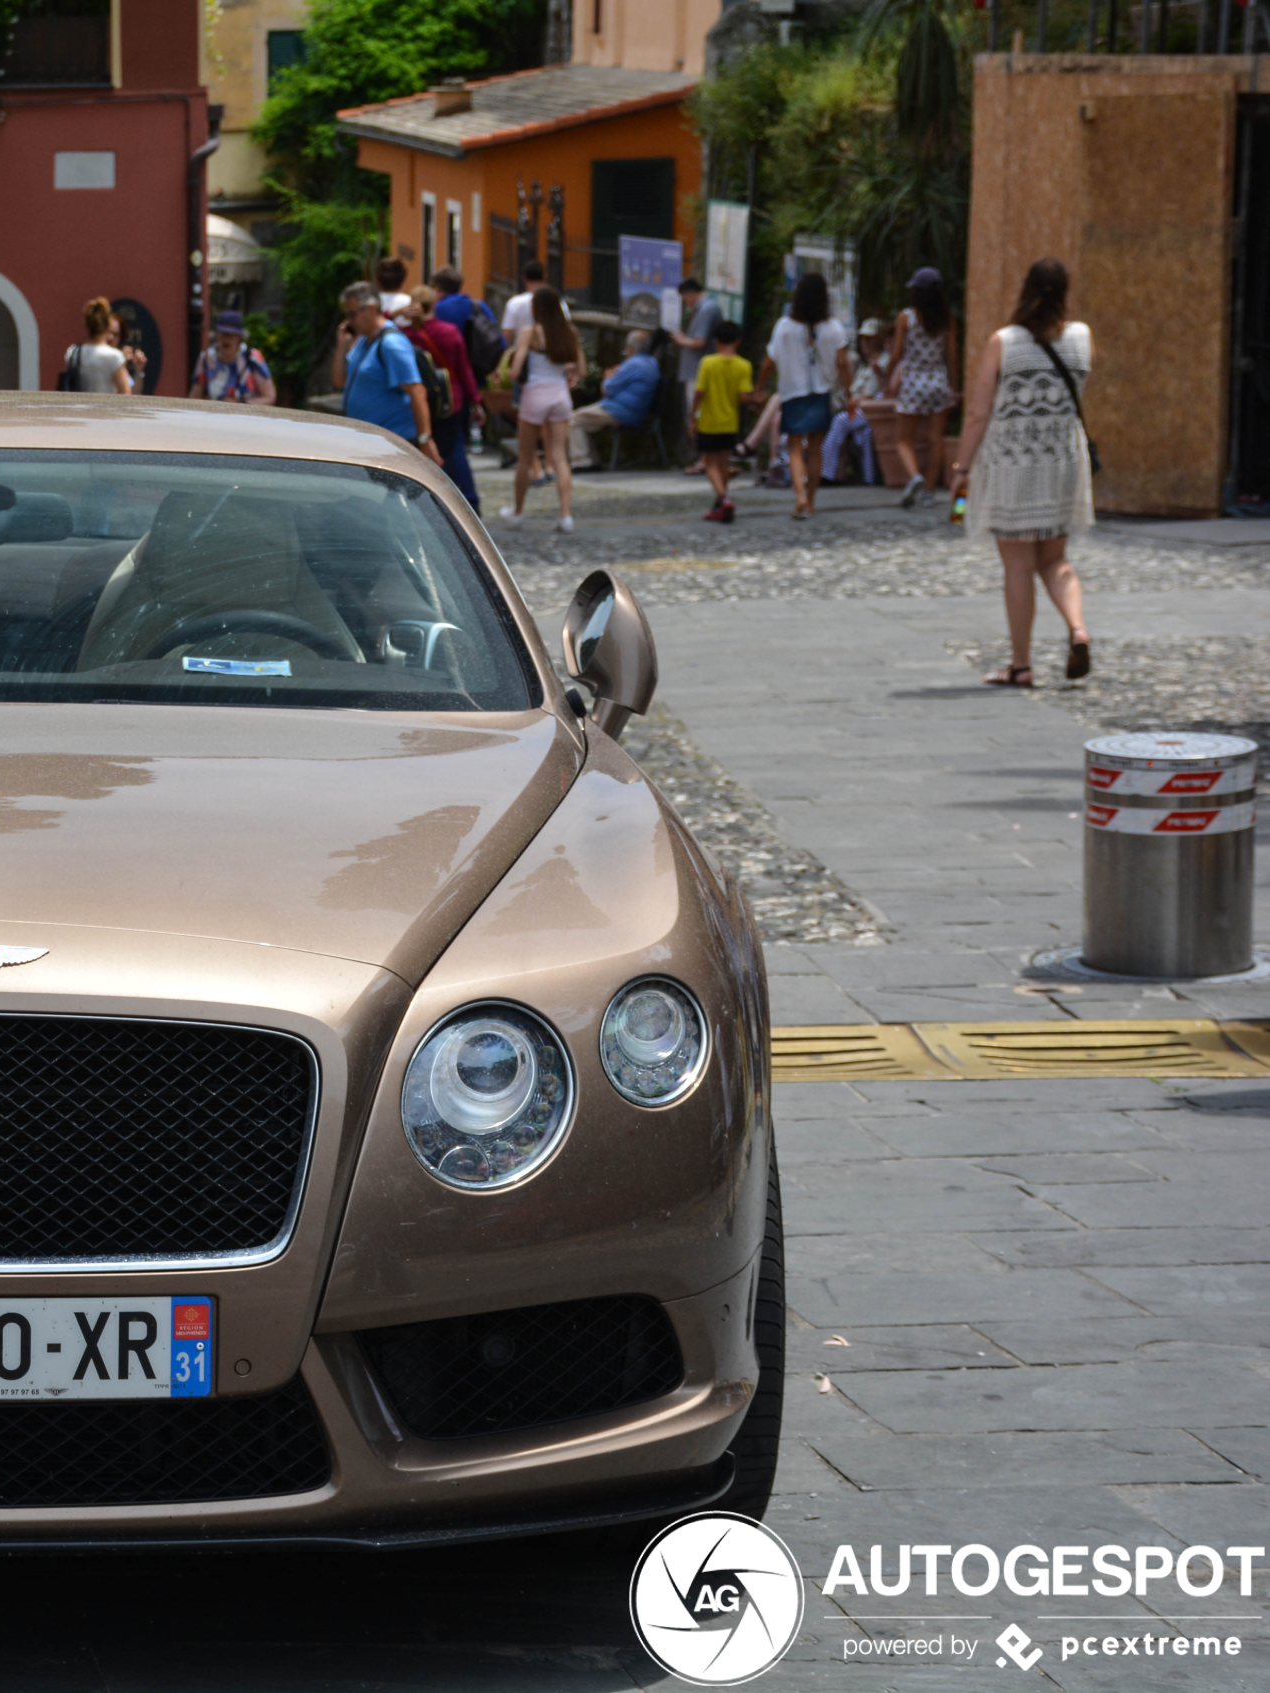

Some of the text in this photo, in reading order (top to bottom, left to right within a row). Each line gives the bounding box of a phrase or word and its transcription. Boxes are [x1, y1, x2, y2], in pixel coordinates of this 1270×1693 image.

[175, 1351, 205, 1382] 31
[0, 1388, 9, 1396] 97
[10, 1388, 20, 1396] 97
[20, 1388, 30, 1396] 97
[31, 1388, 40, 1396] 65
